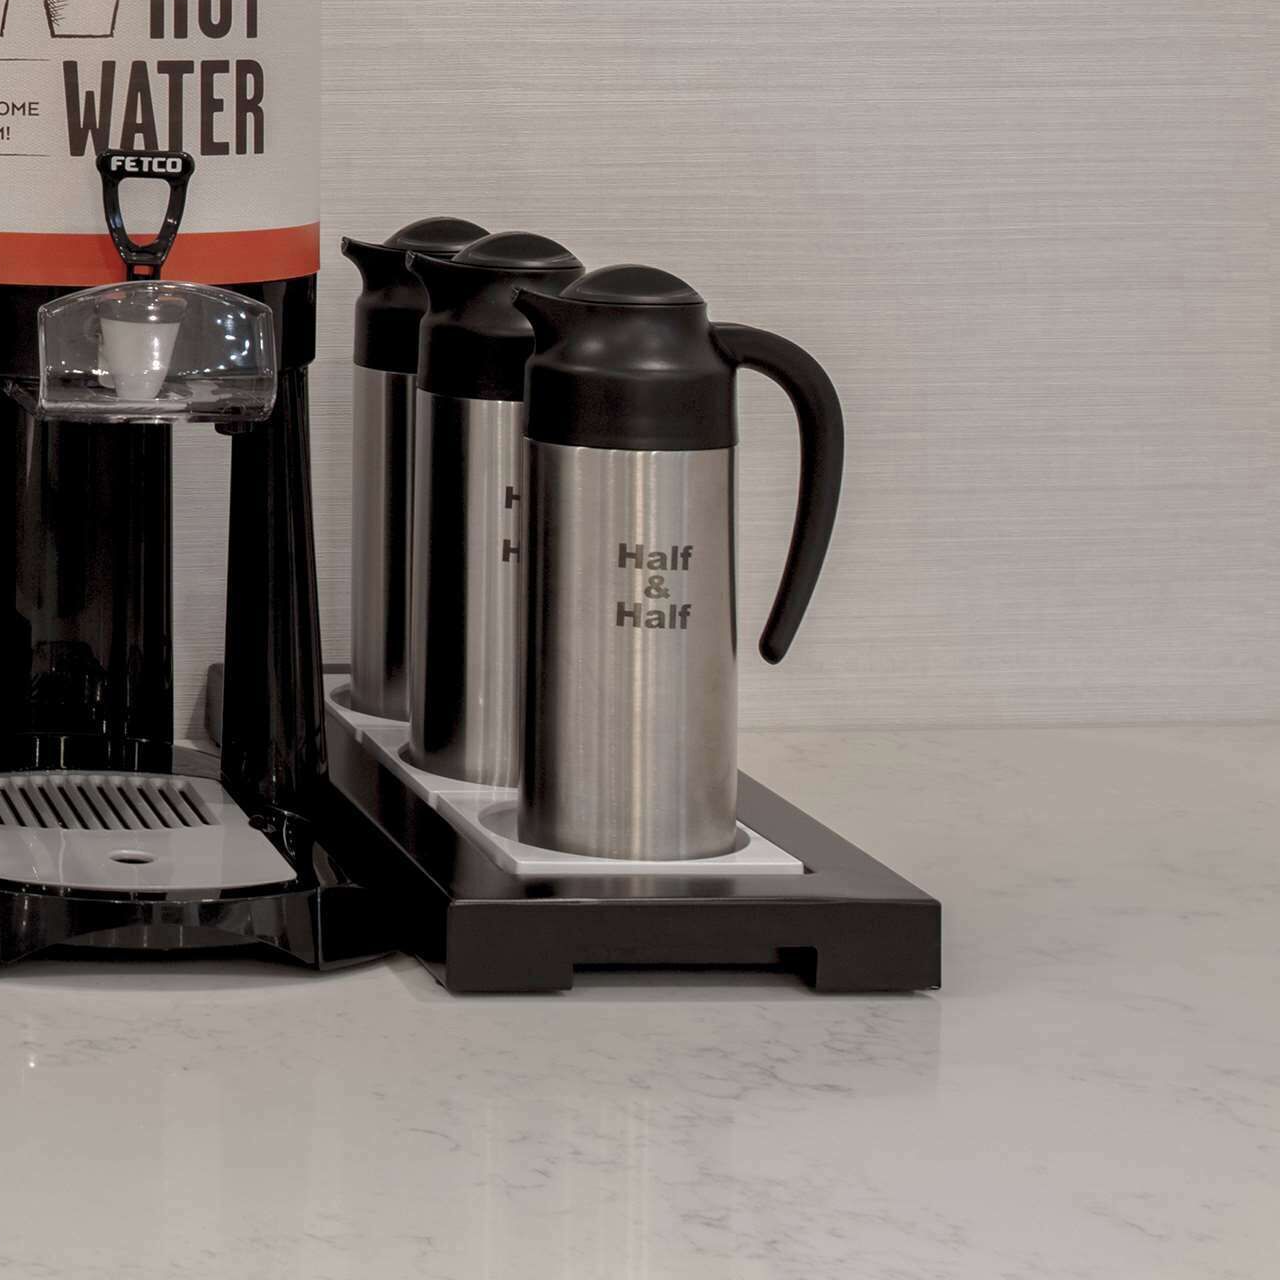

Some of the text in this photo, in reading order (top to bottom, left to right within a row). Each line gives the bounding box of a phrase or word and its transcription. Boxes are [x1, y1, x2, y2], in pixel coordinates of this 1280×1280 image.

[63, 59, 265, 157] WATER
[111, 157, 182, 174] FETCO
[617, 543, 693, 572] Half
[644, 574, 670, 599] &
[615, 602, 691, 630] Half
